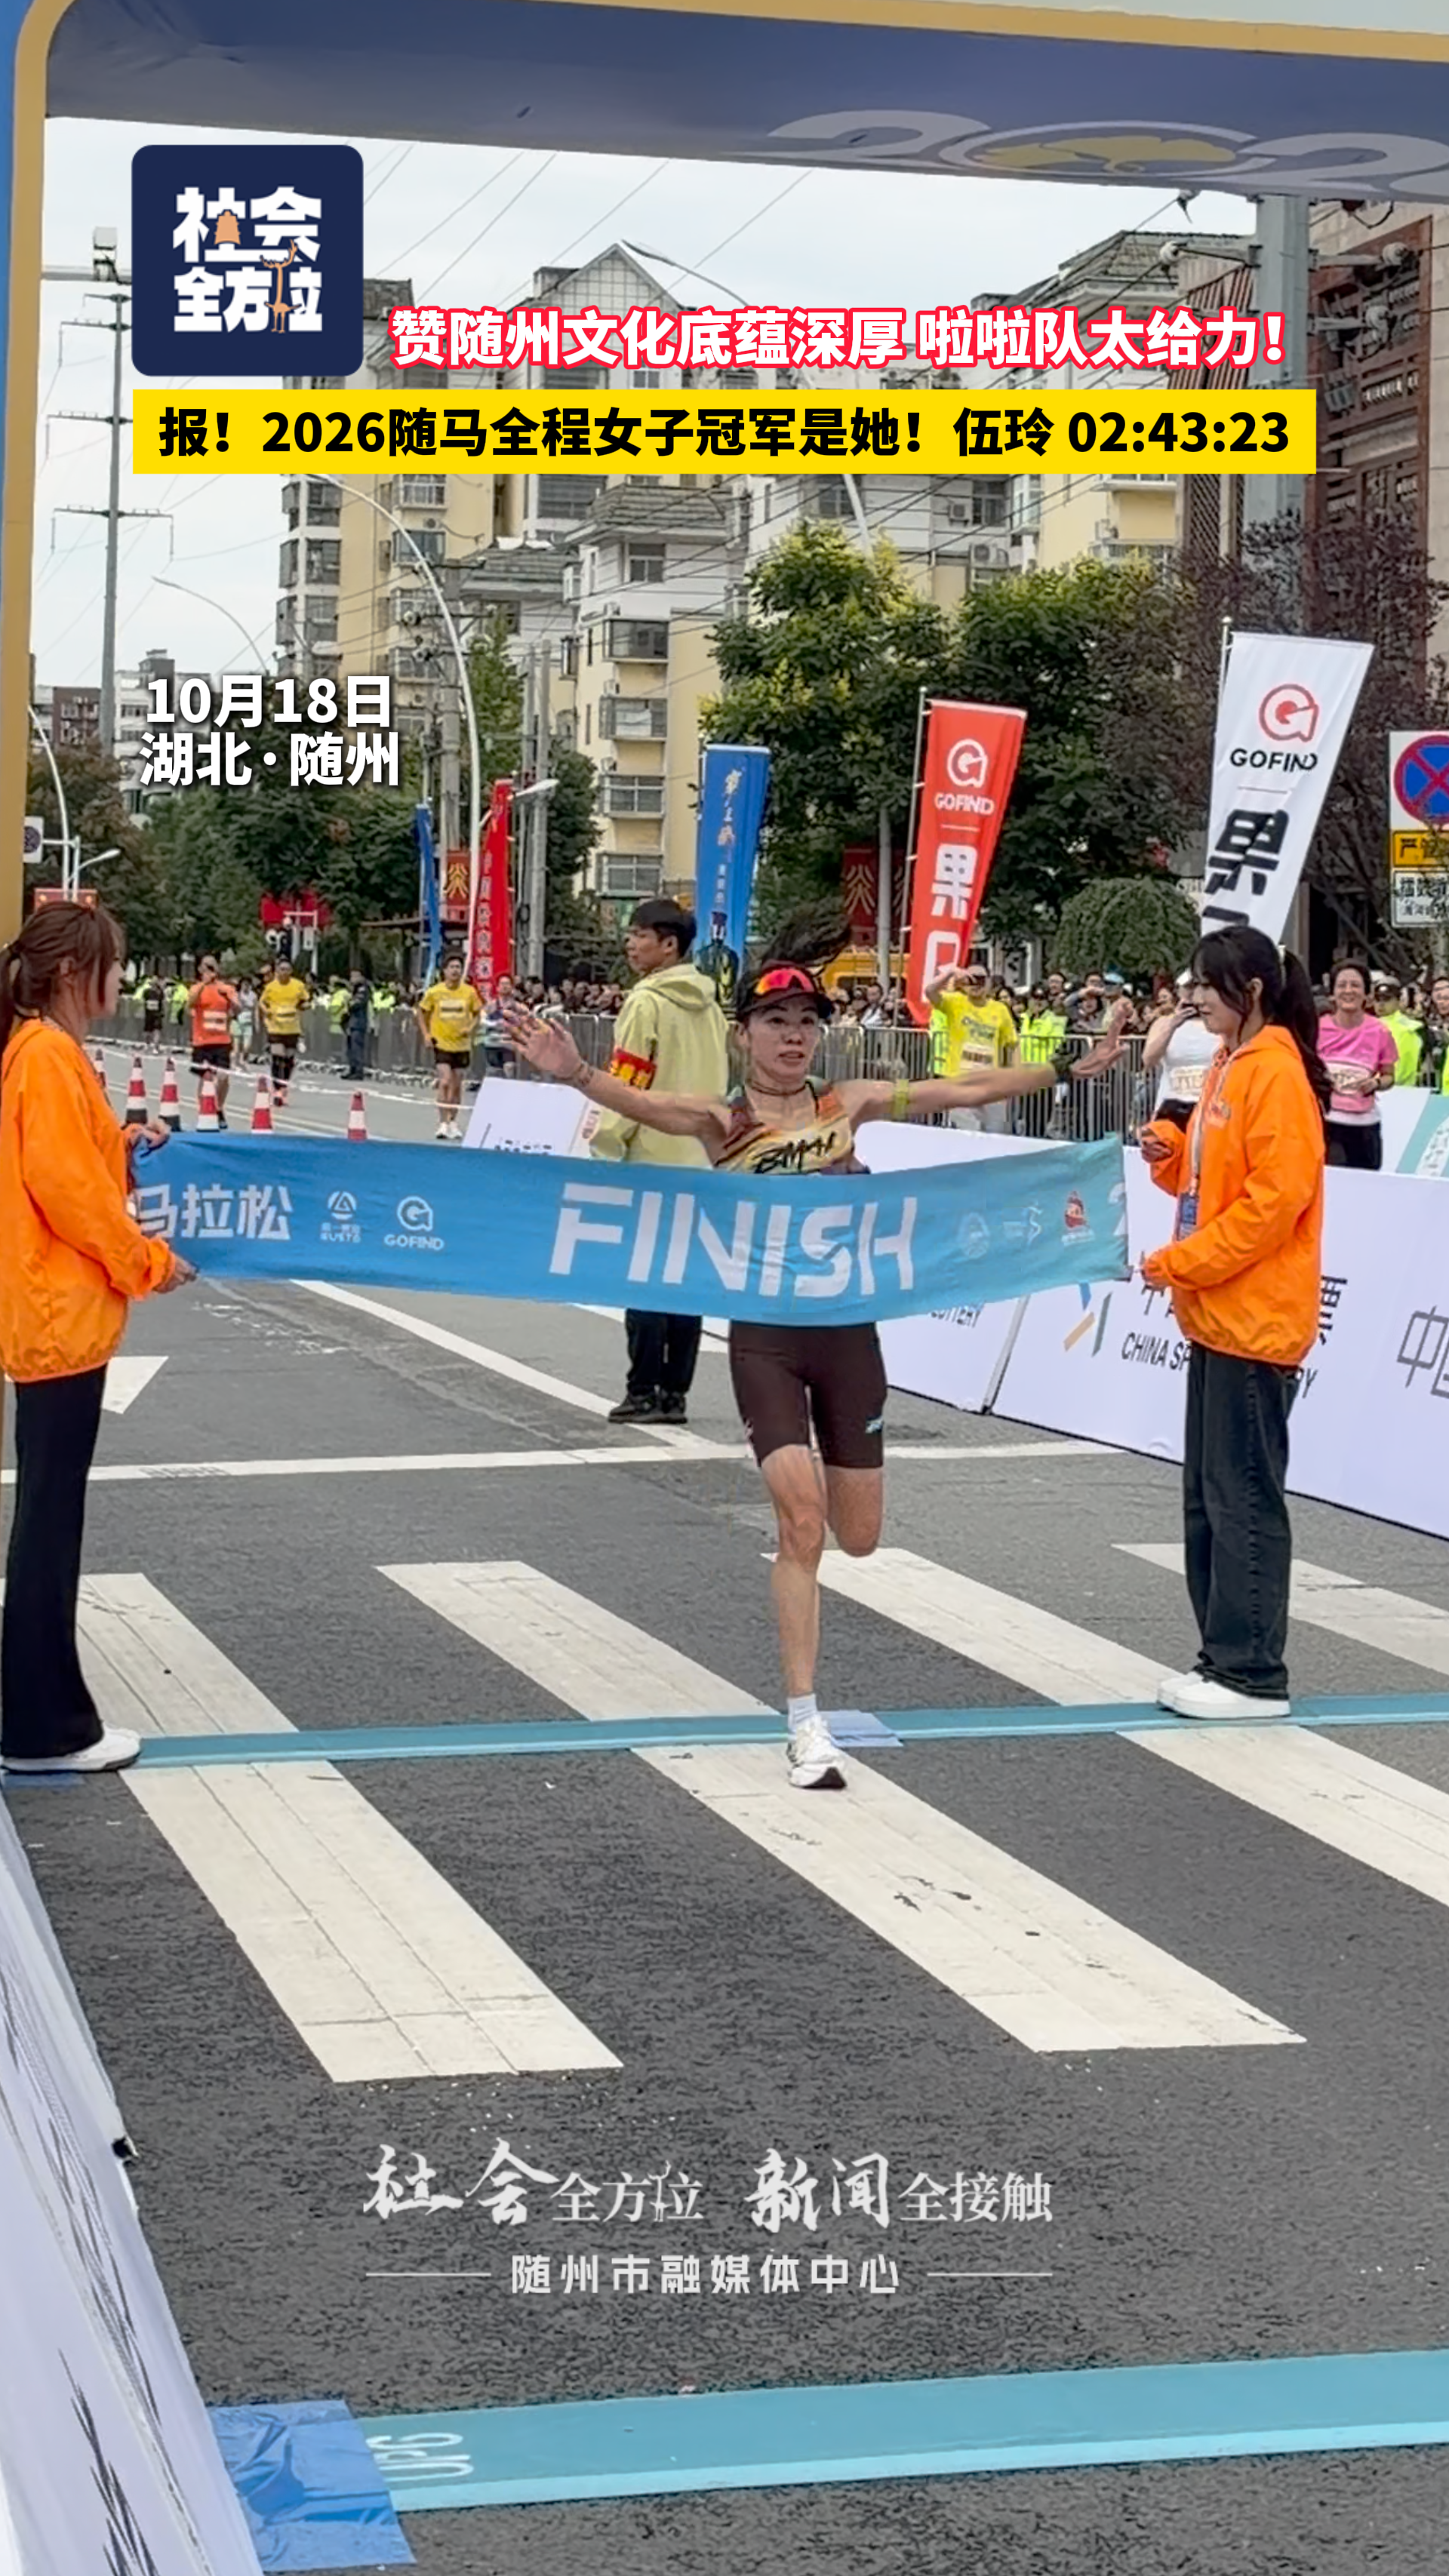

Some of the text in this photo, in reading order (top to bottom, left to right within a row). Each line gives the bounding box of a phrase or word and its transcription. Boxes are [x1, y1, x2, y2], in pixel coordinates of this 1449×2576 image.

[1229, 749, 1318, 772] GOFIND
[934, 792, 995, 816] GOFIND
[139, 1182, 294, 1240] 马拉松
[383, 1234, 445, 1250] GOFIND
[549, 1182, 917, 1299] FINISH
[1121, 1333, 1168, 1367] CHINA
